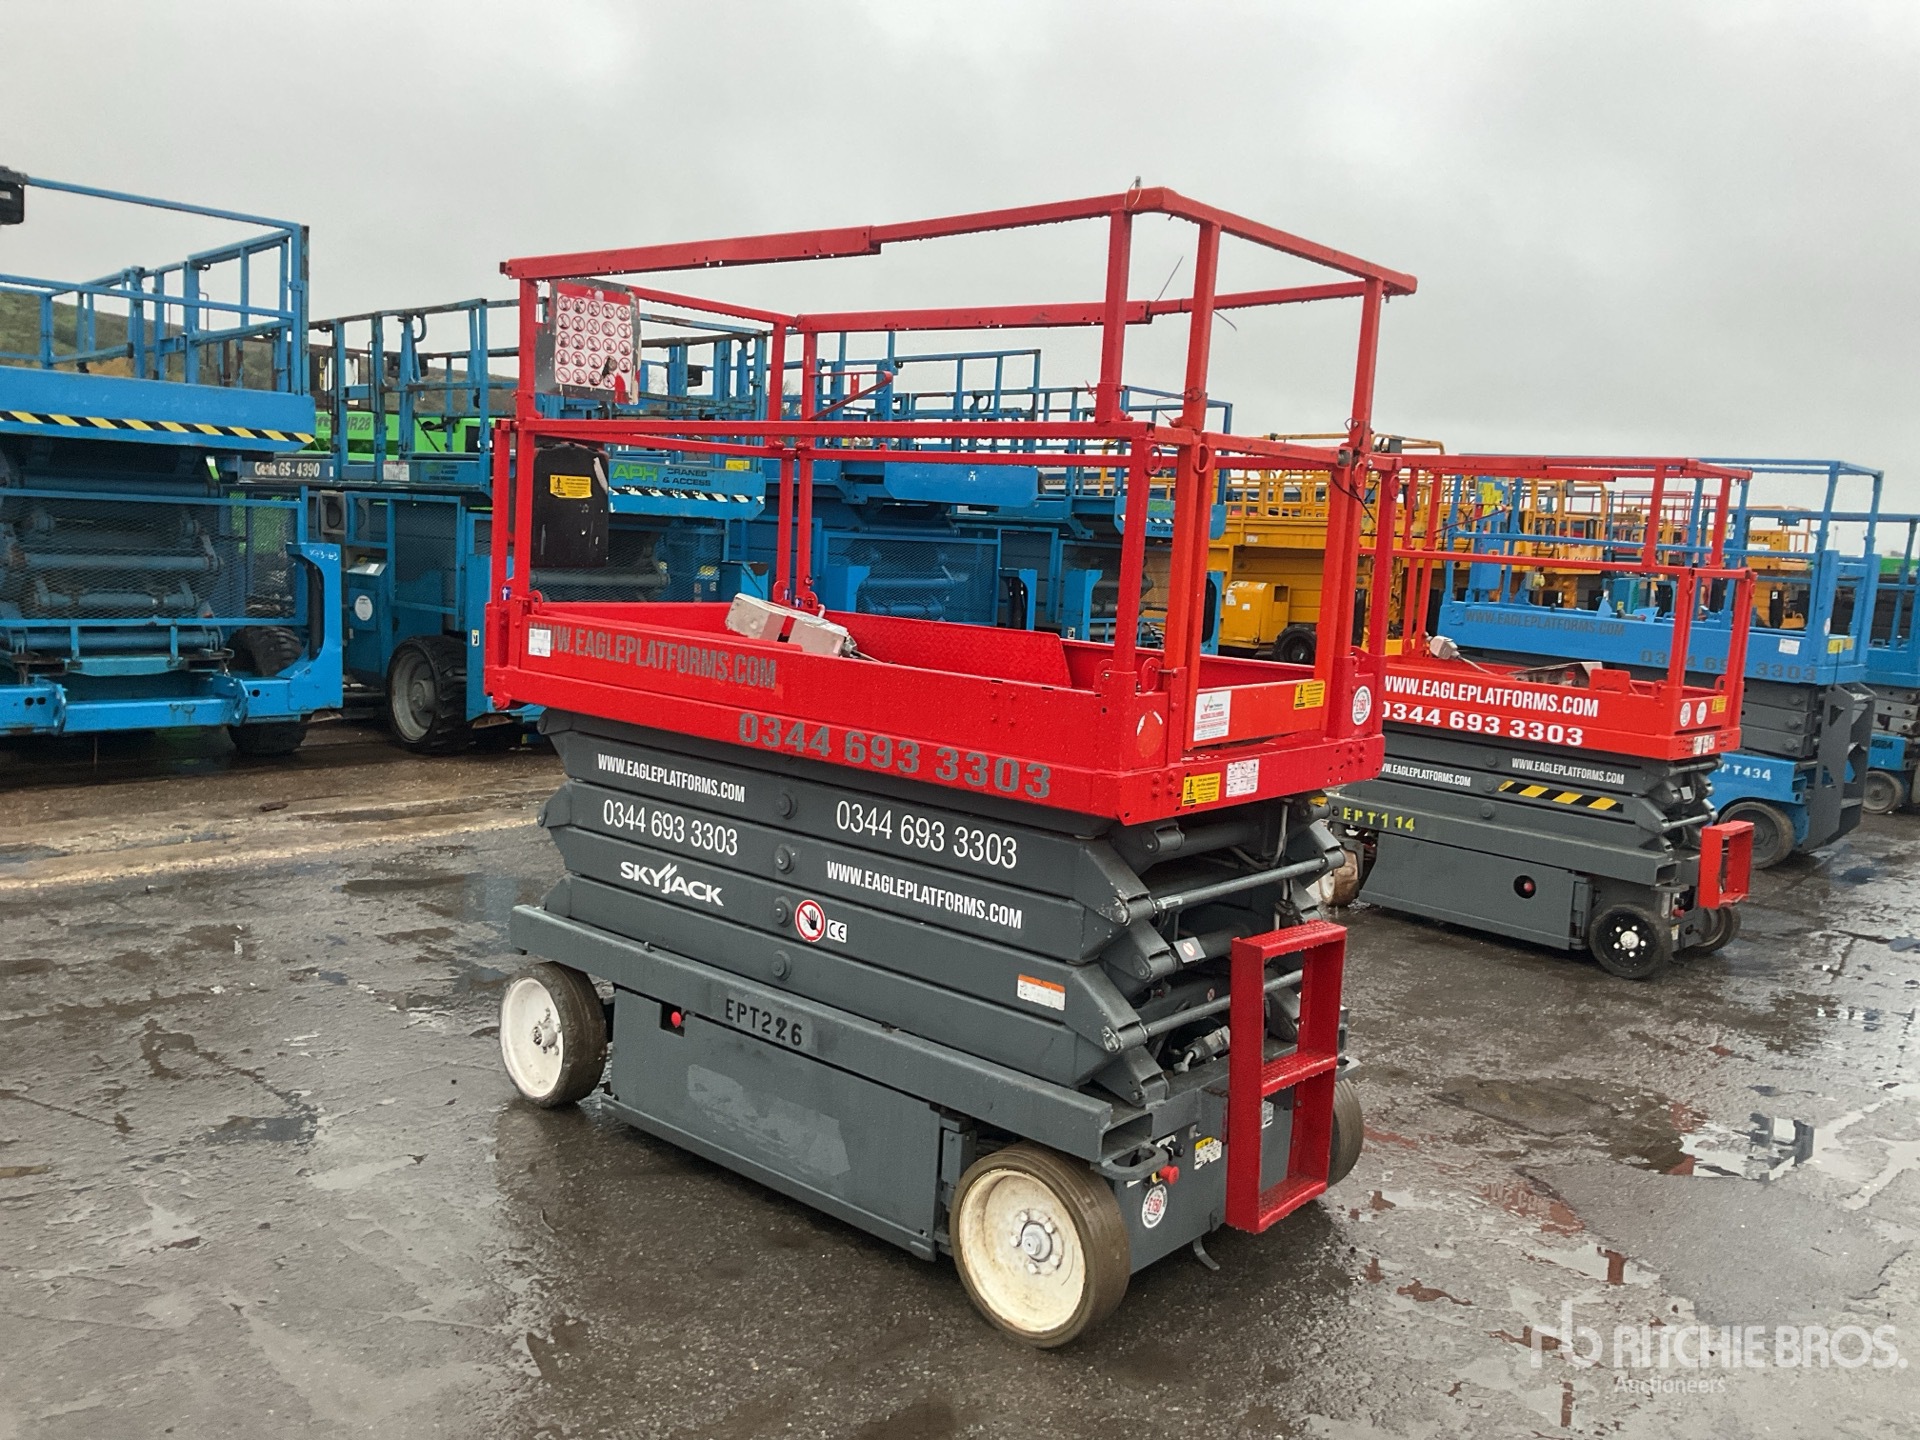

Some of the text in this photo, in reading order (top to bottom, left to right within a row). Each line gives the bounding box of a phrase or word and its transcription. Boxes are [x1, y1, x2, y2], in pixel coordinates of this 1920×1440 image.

[1755, 662, 1817, 682] 3303
[1449, 710, 1501, 734] 693
[1509, 719, 1584, 746] 3303
[597, 753, 746, 803] WWW.EAGLEPLATFORMS.COM
[739, 712, 1051, 798] 0344 693 3303
[1511, 757, 1625, 786] WWW.EAGLEPLATFORMS.COM
[603, 799, 738, 856] 0344 693 3303
[836, 800, 1017, 869] 0344 693 3303
[826, 860, 1023, 930] WWW.EAGLEPLATFORMS.COM
[725, 998, 803, 1047] EPT226
